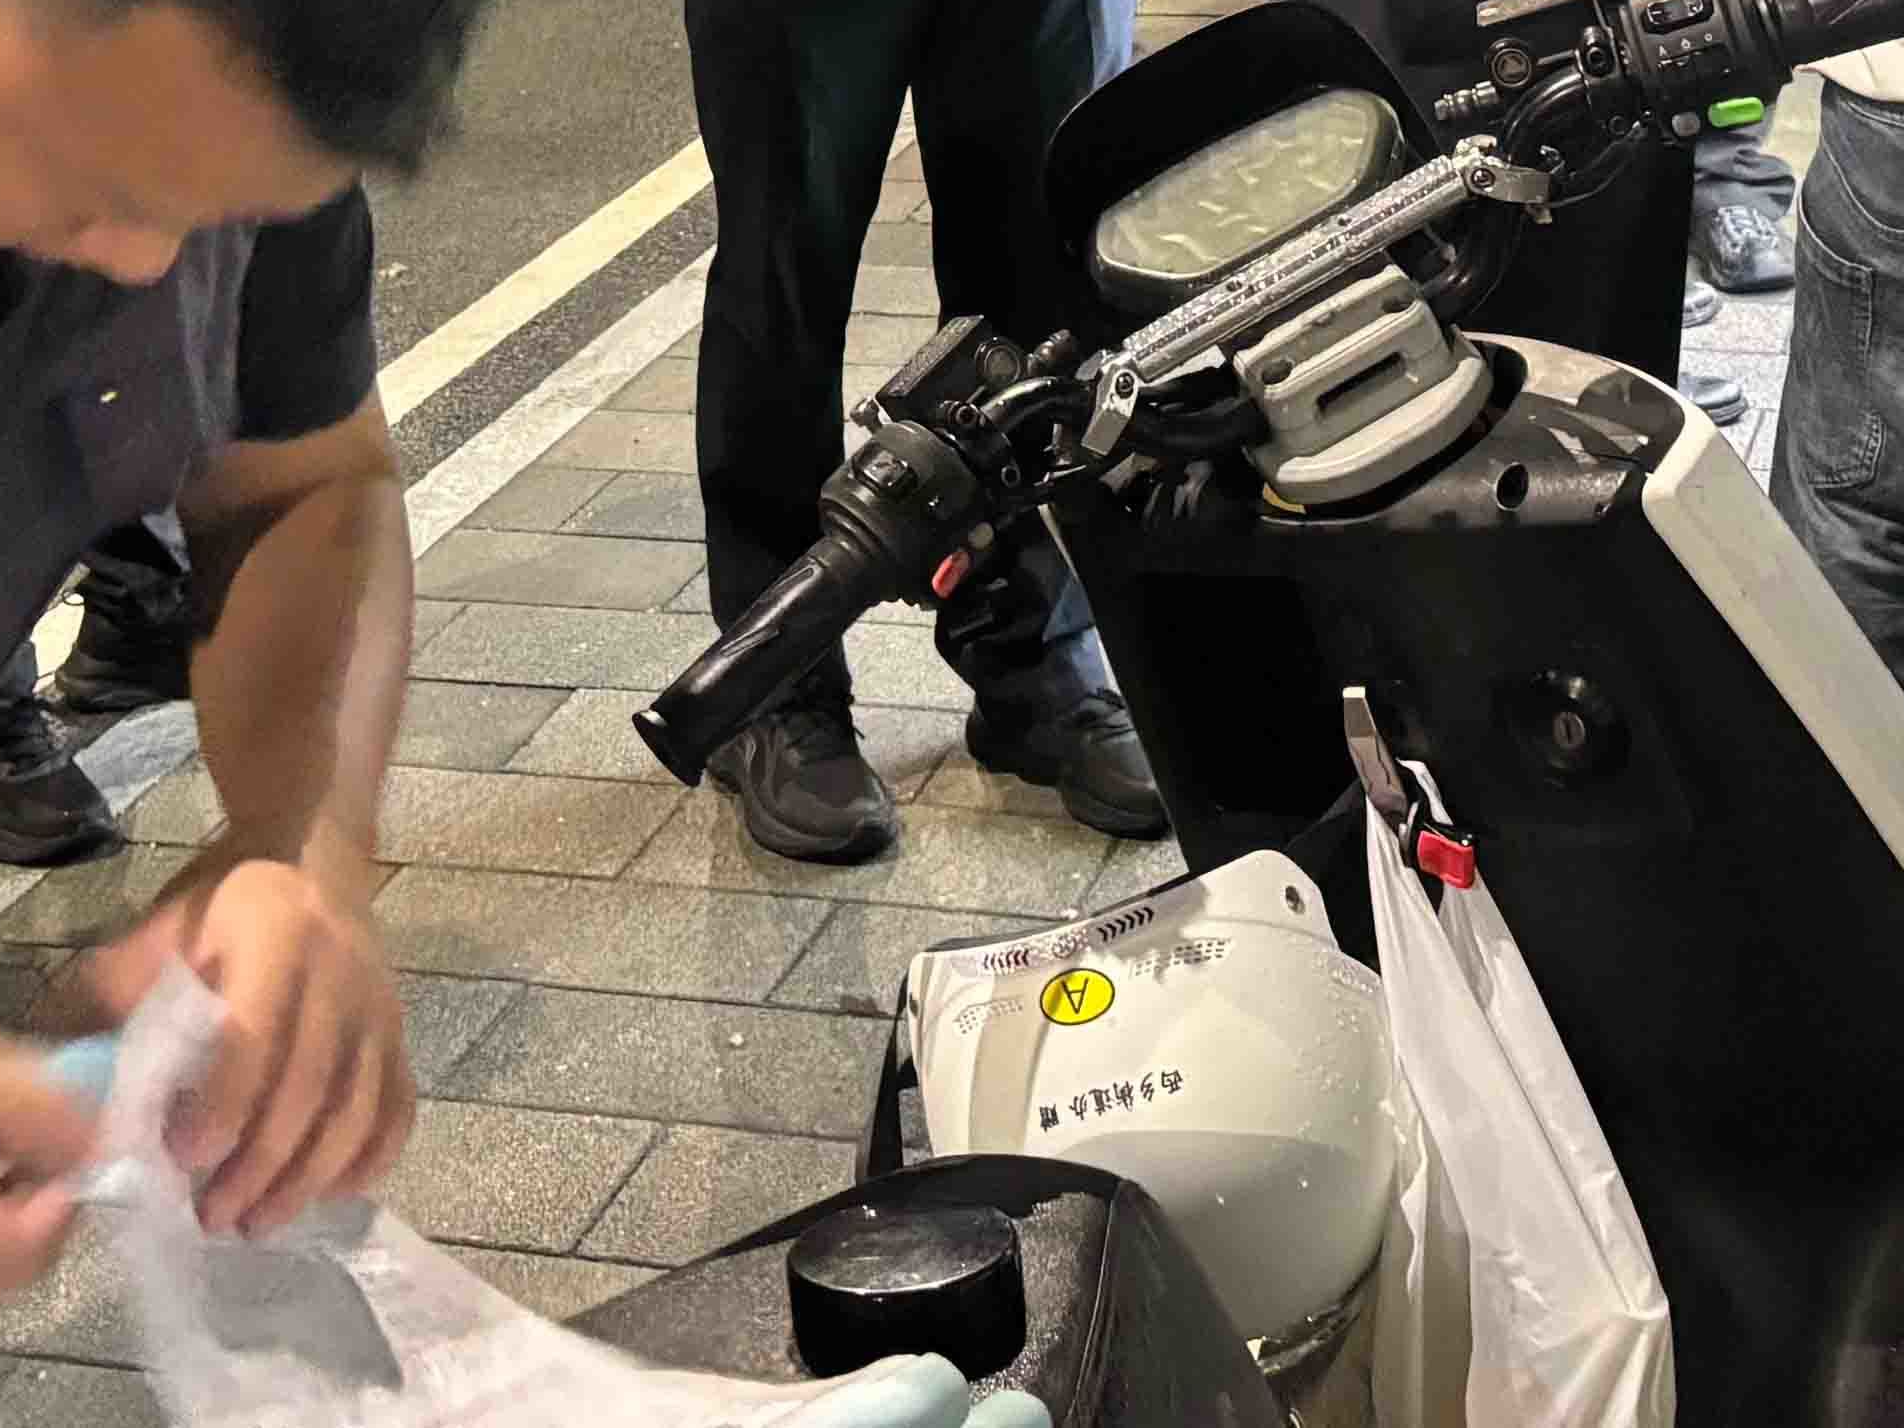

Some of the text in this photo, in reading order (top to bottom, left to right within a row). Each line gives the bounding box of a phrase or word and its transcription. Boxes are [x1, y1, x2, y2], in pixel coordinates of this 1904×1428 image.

[1060, 976, 1089, 1015] A
[1069, 1069, 1183, 1121] 西乡街道办
